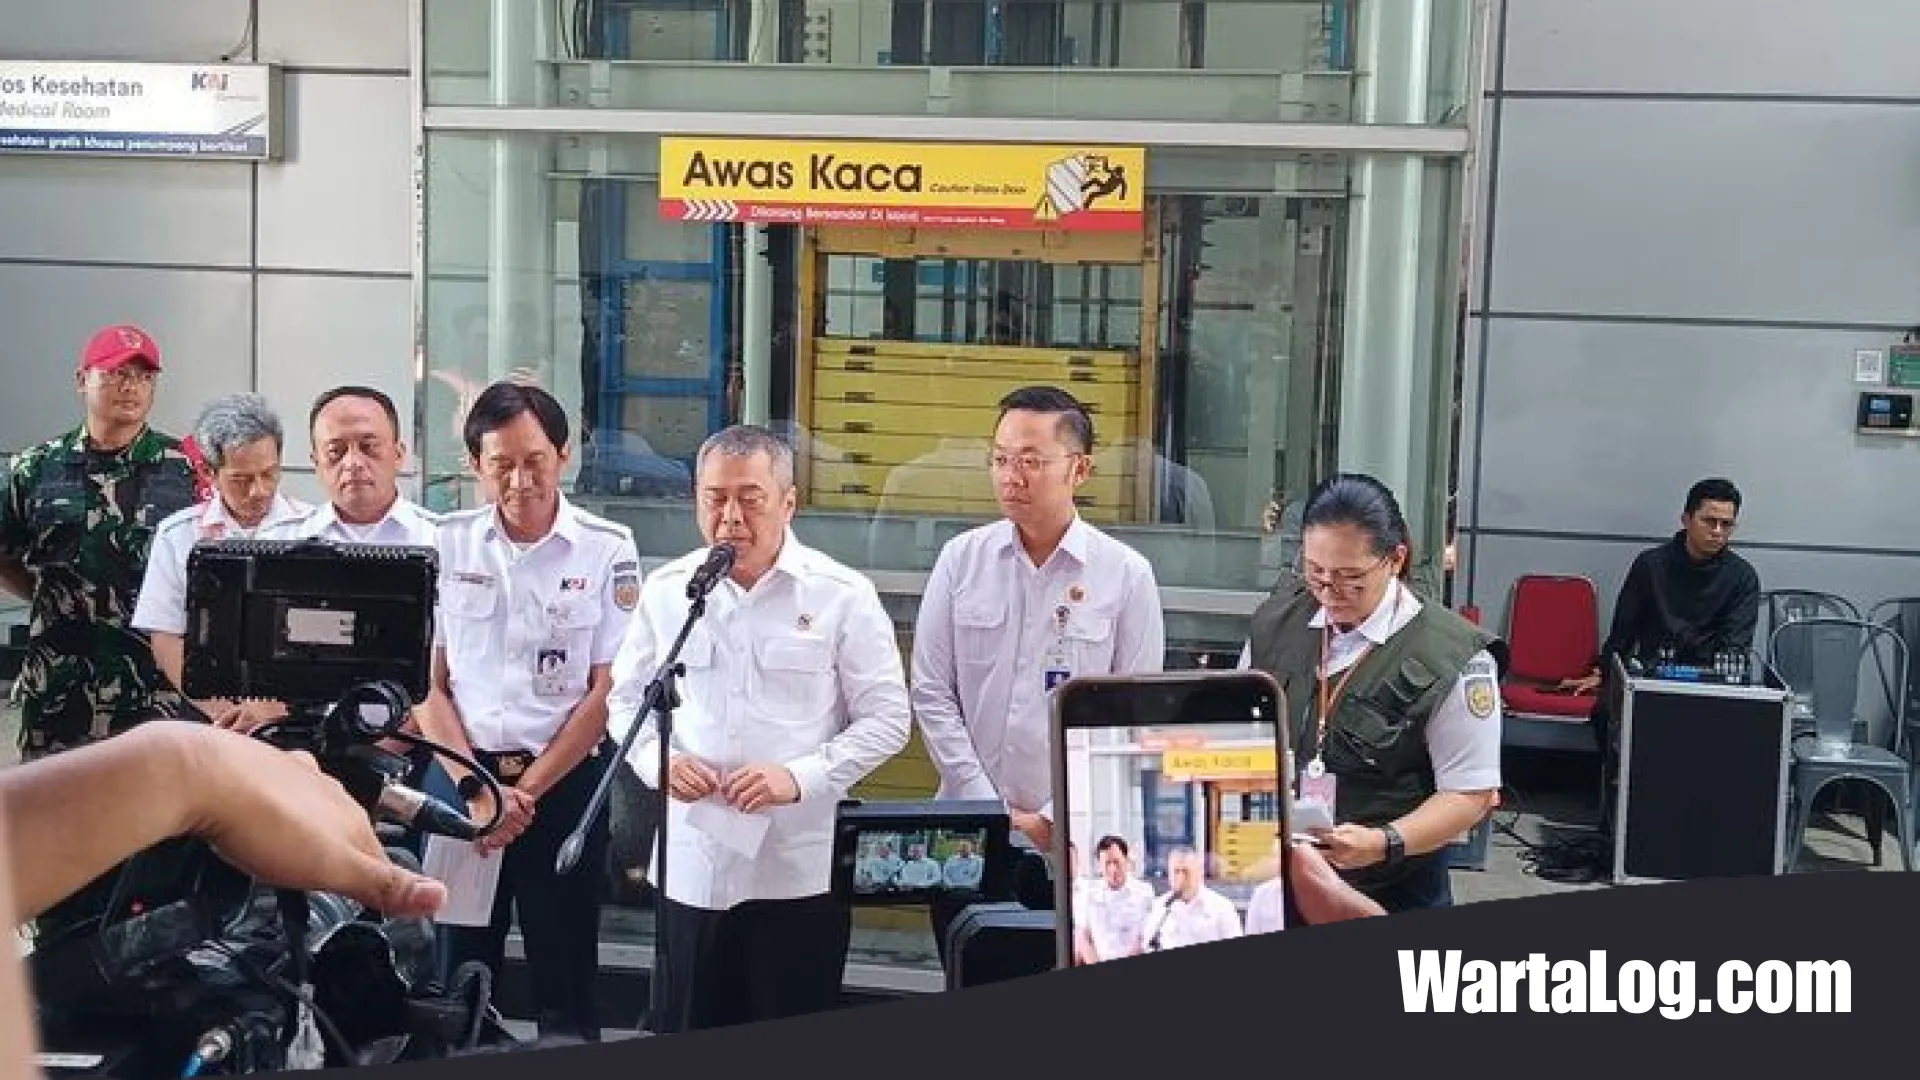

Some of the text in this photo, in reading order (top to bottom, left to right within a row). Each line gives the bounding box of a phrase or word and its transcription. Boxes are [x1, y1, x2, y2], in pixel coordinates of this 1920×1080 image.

[0, 73, 143, 97] os Kesehatan
[62, 101, 111, 119] Room
[682, 150, 922, 193] Awas Kaca
